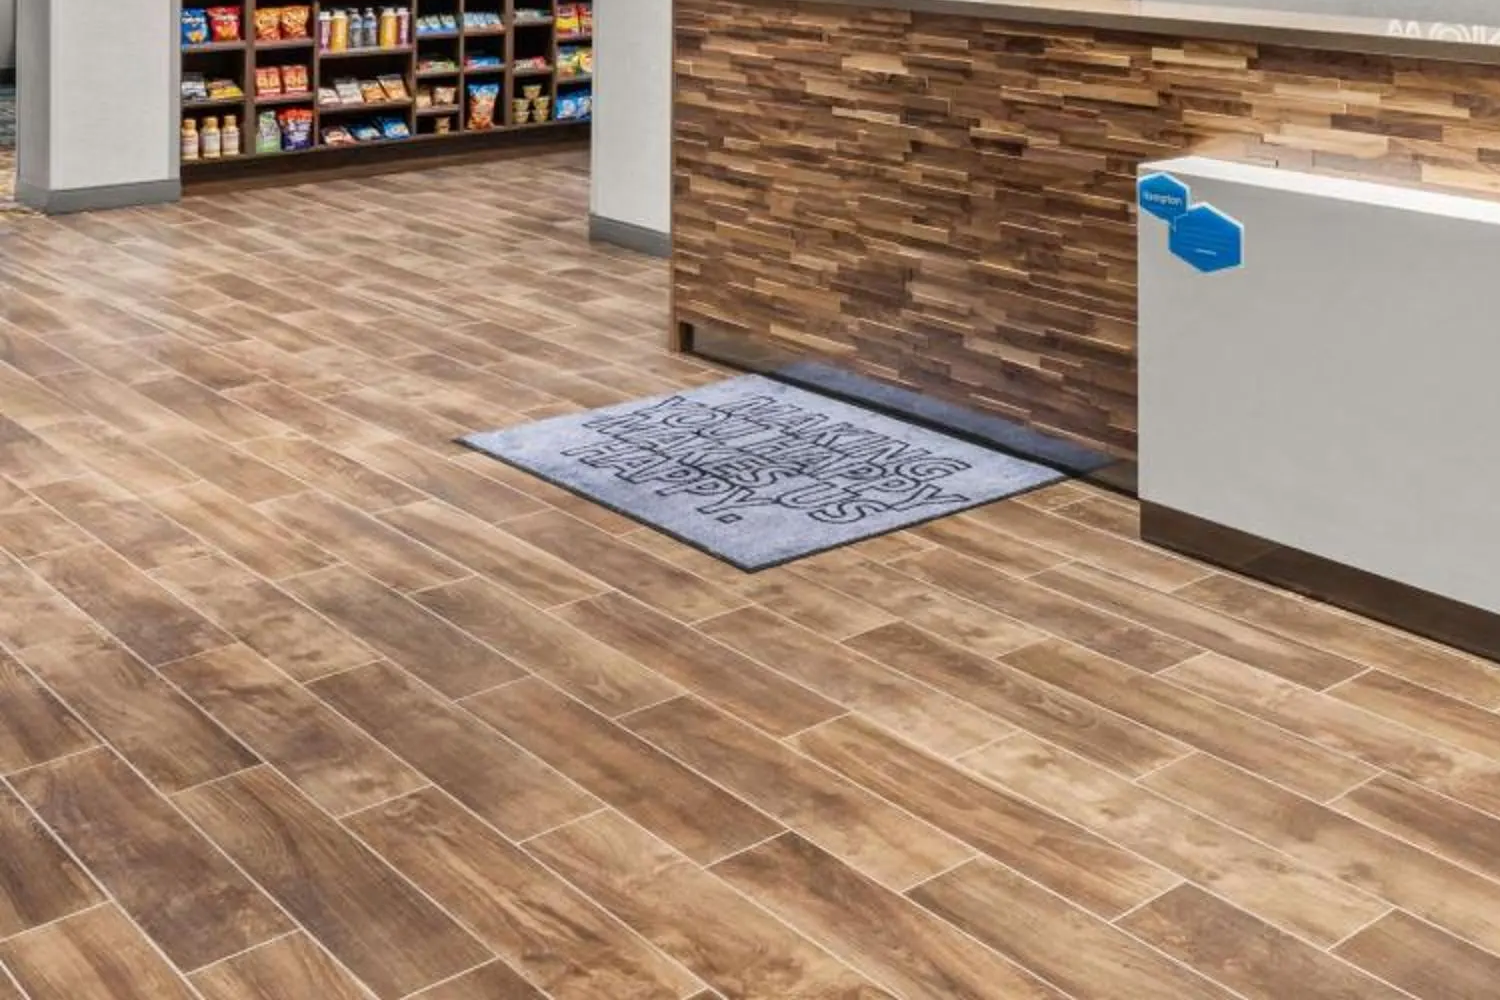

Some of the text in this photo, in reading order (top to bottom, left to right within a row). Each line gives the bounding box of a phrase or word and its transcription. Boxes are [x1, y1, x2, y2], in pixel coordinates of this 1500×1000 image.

[559, 438, 774, 524] HAPPY.
[581, 411, 896, 525] MAKES US
[630, 394, 970, 514] YOU HAPPY
[714, 394, 974, 483] MAKING
